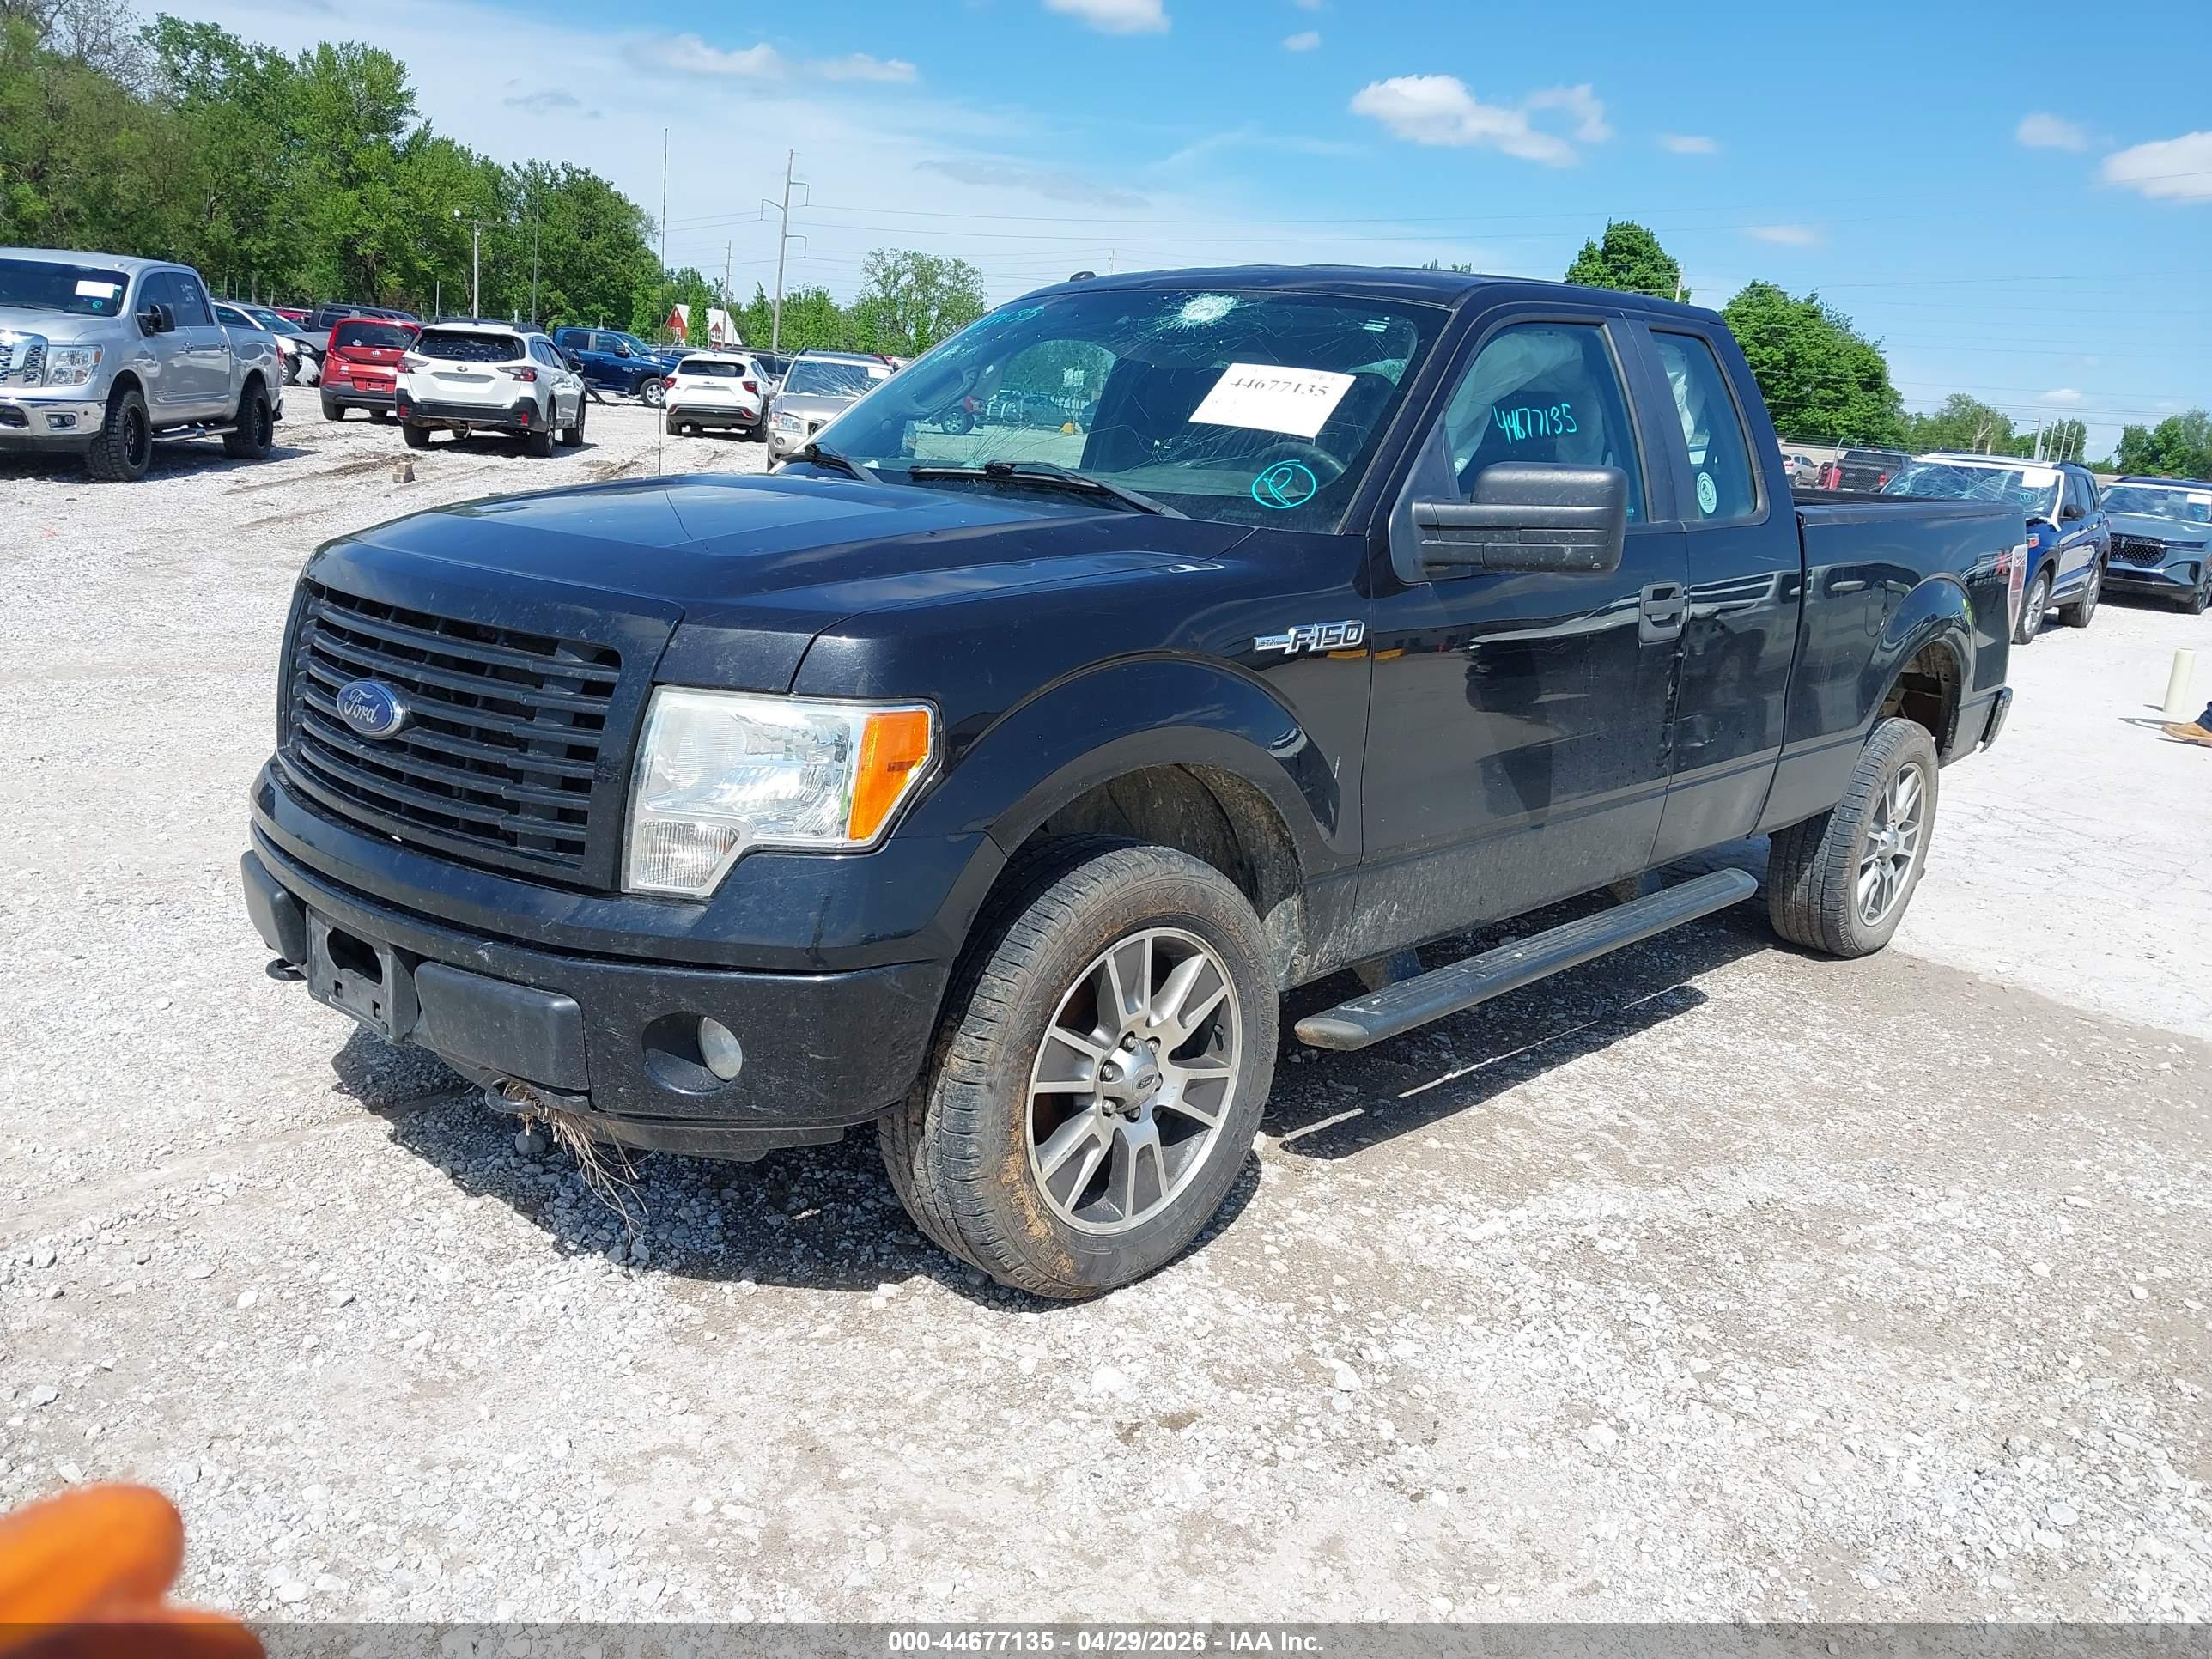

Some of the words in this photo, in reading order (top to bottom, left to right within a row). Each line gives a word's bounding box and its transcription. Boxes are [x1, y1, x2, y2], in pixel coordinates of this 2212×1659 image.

[1231, 376, 1331, 398] 44677135
[1492, 403, 1577, 445] 44677135
[1258, 638, 1279, 647] STX
[343, 688, 380, 724] Ford
